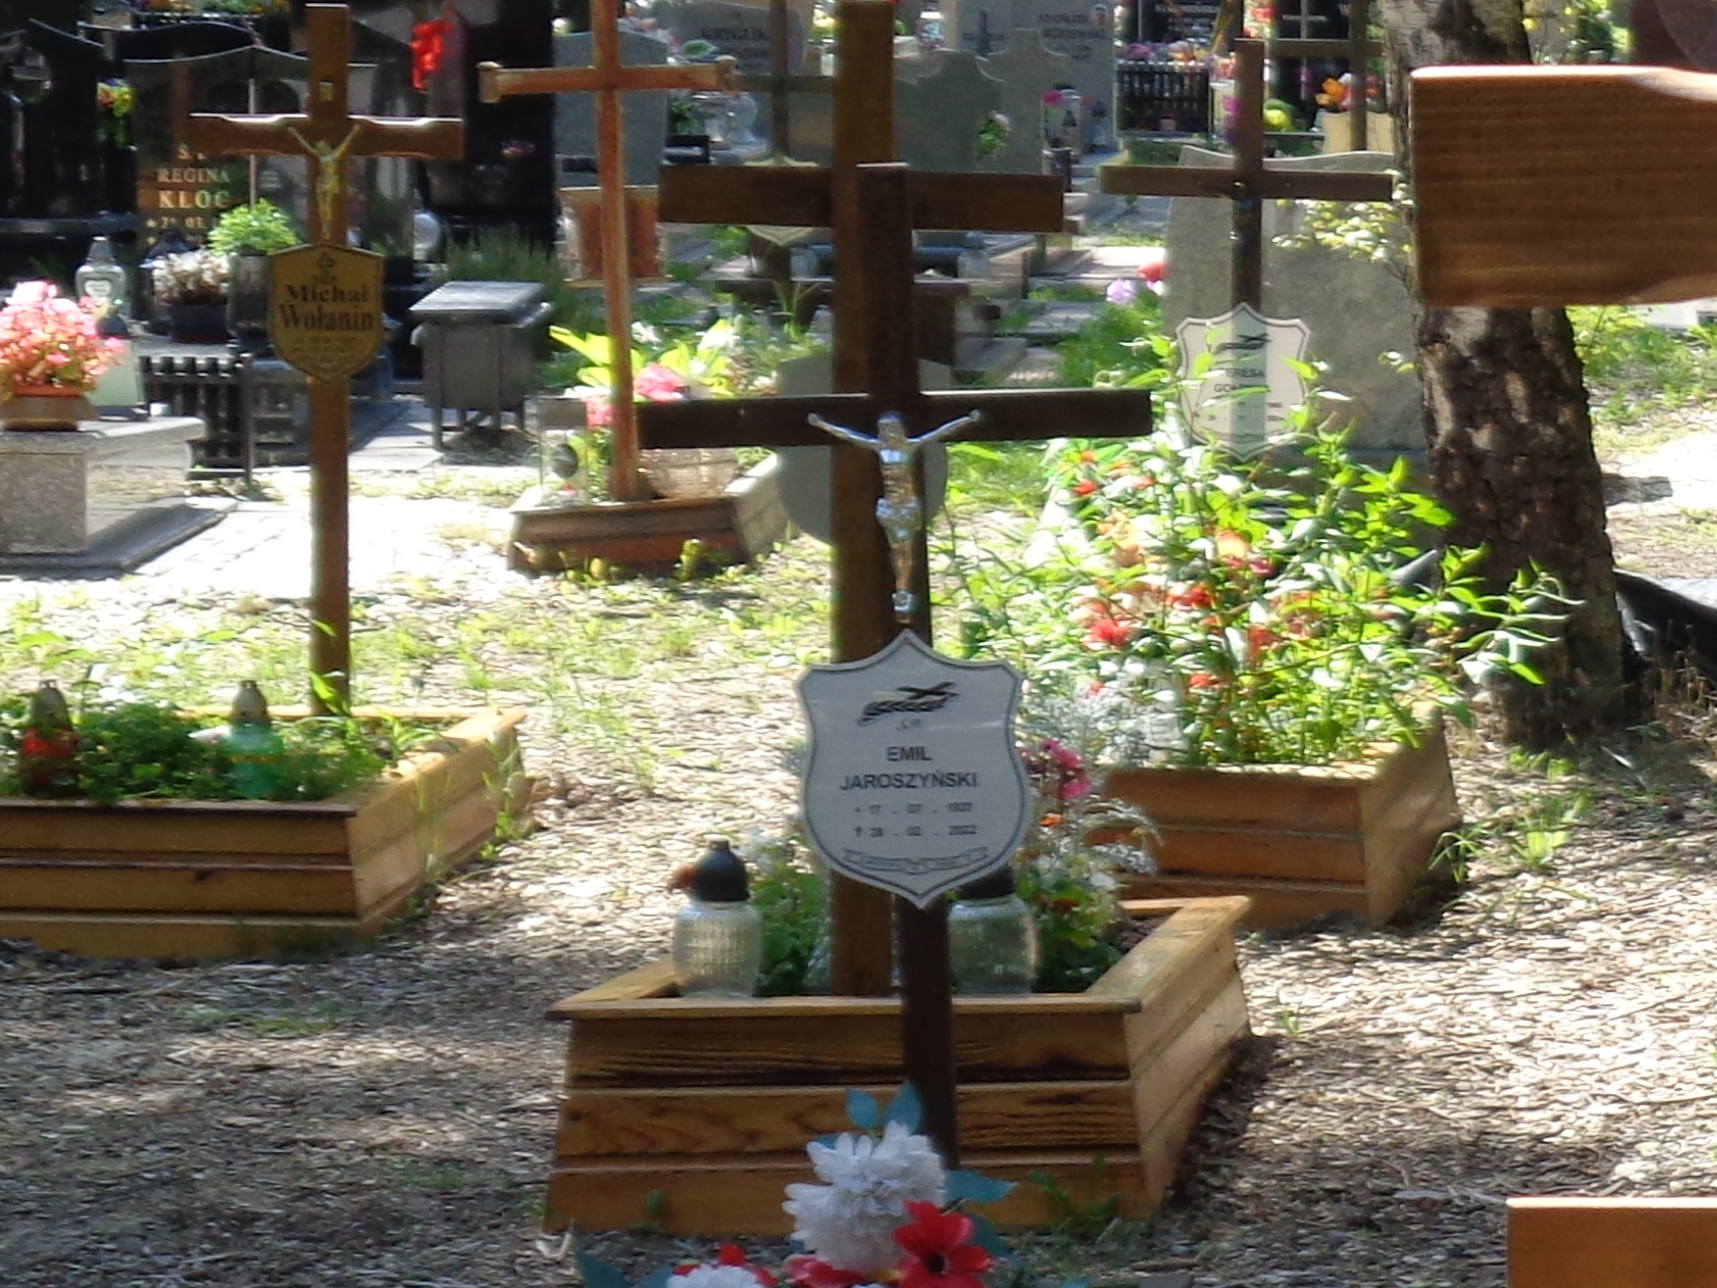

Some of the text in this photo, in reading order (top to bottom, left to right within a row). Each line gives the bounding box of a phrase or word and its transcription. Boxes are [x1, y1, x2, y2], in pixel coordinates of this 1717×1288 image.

[157, 167, 230, 183] REGINA
[887, 746, 933, 762] EMIL
[839, 769, 978, 791] JAROSZYŃSKI
